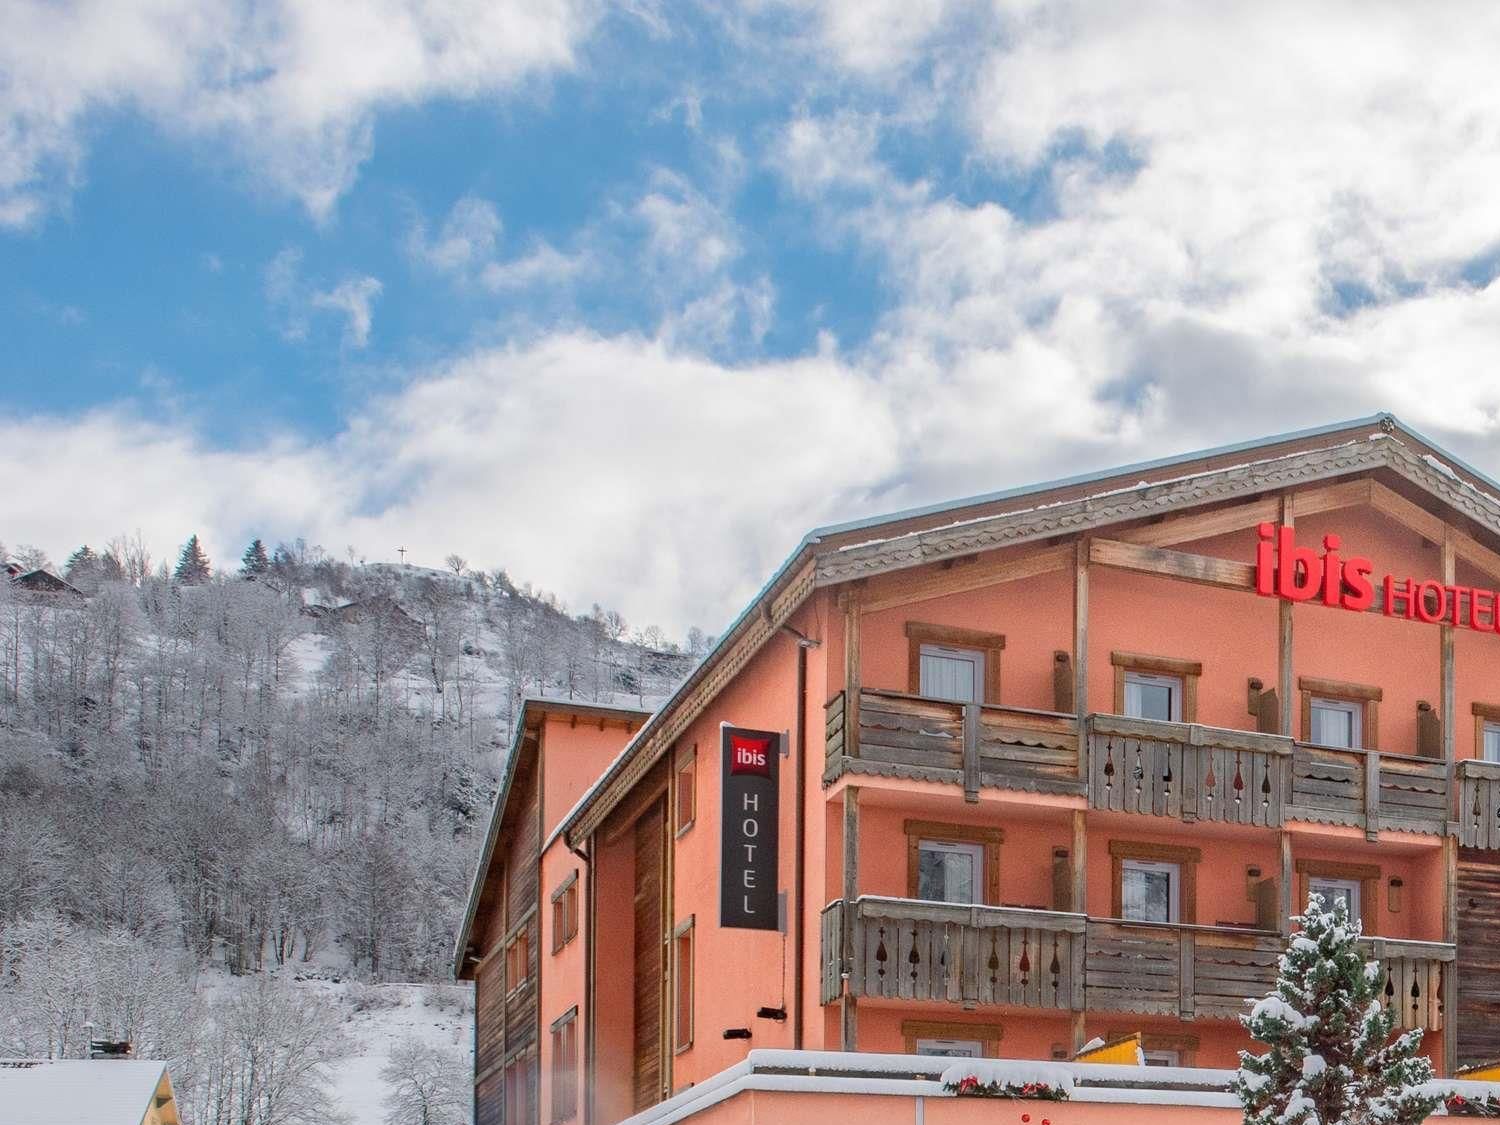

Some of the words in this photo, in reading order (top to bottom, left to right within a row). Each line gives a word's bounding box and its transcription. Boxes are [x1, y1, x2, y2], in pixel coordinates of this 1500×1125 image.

[1256, 522, 1376, 612] ibis
[737, 748, 766, 767] ibis
[742, 793, 759, 914] HOTEL
